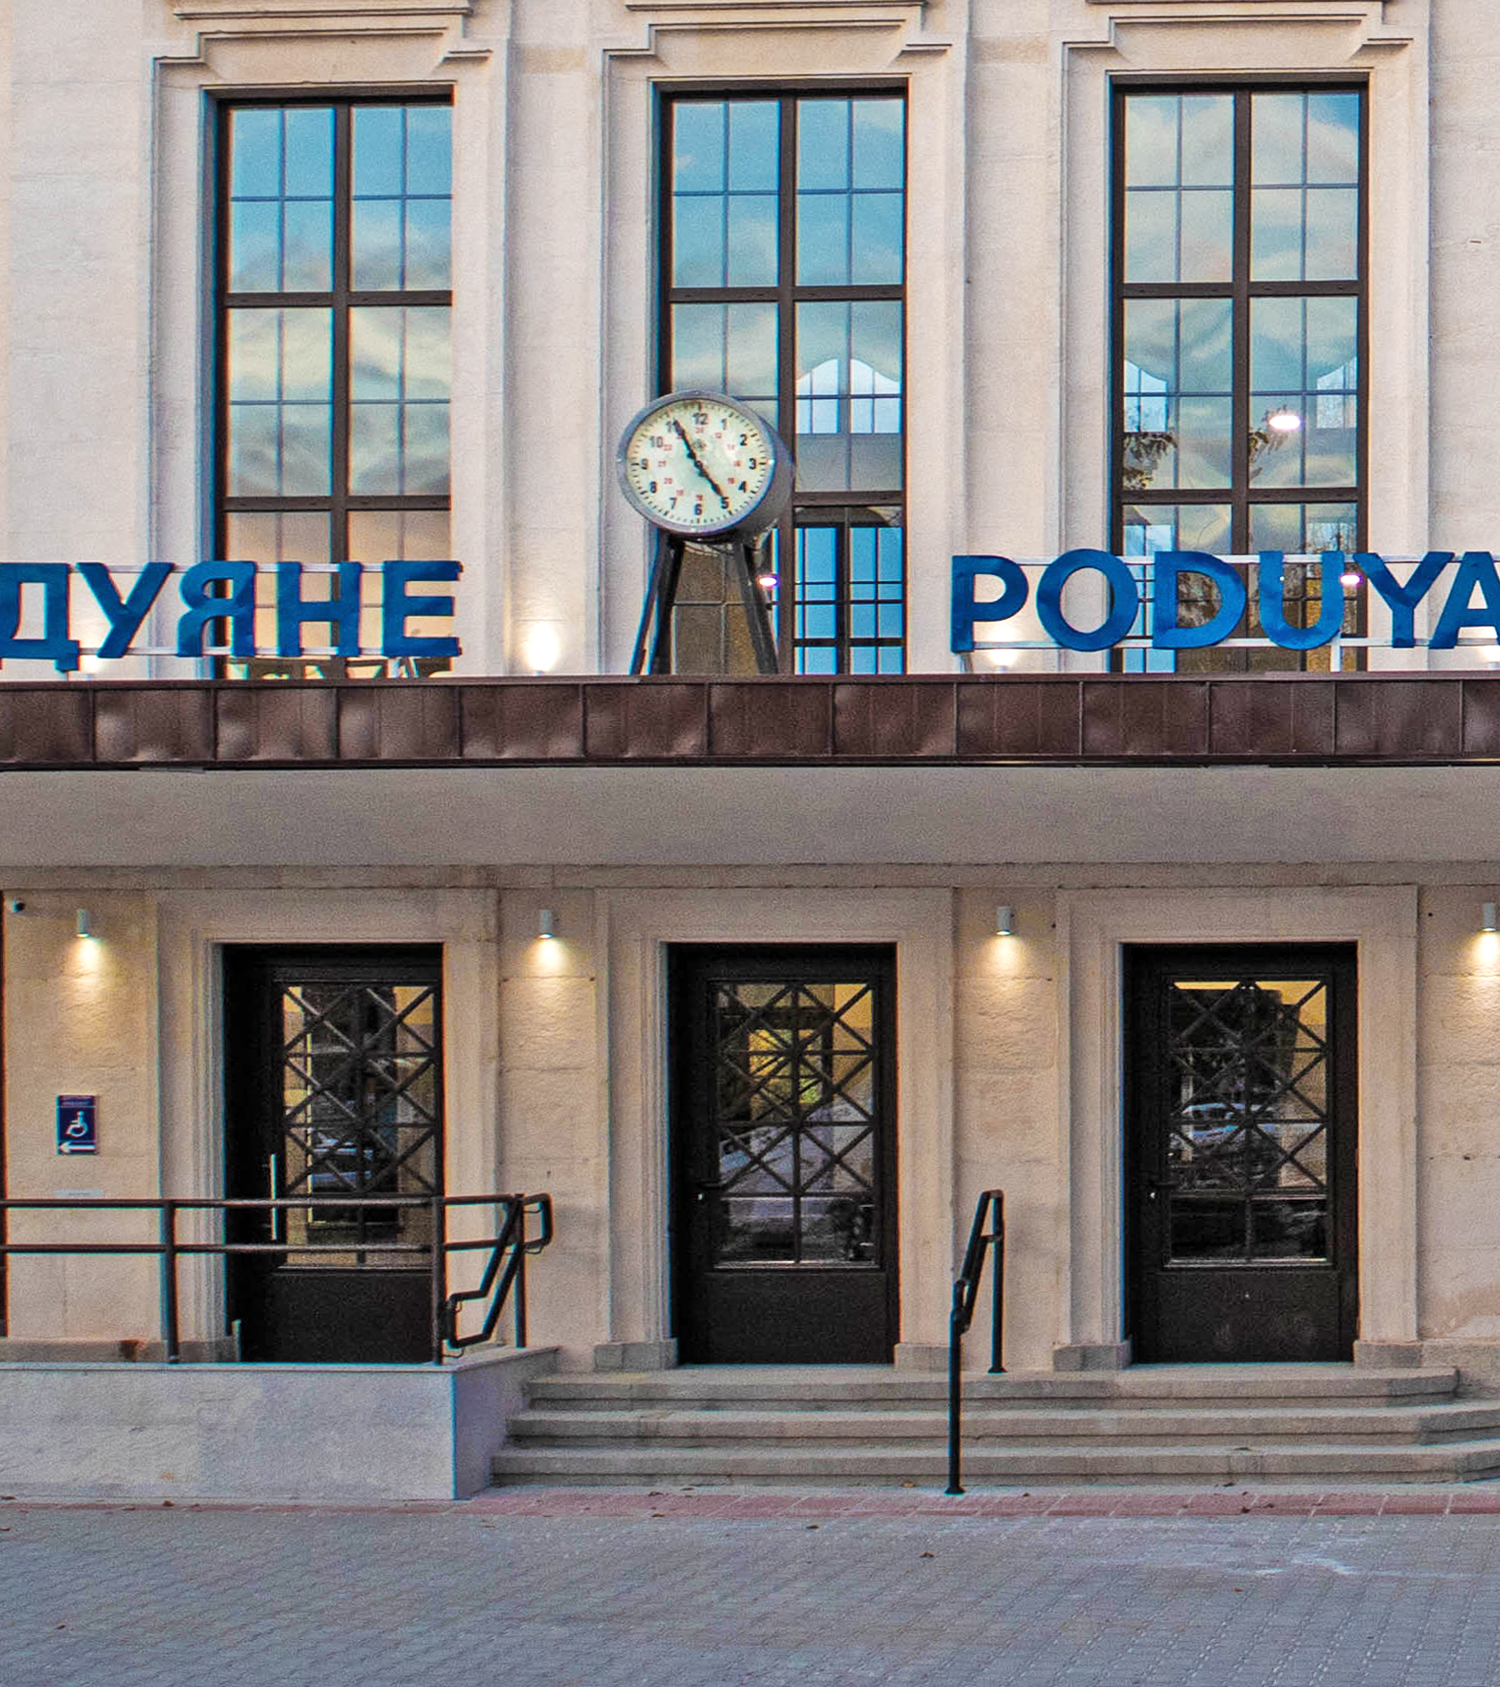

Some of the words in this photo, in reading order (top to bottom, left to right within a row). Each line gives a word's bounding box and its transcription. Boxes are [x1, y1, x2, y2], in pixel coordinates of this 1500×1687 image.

[692, 413, 708, 425] 12
[720, 418, 728, 431] 1
[649, 436, 664, 448] 10
[739, 434, 748, 446] 2
[640, 458, 649, 470] 9
[748, 457, 757, 470] 3
[649, 481, 657, 493] 8
[738, 481, 747, 493] 4
[669, 497, 677, 509] 7
[720, 496, 730, 509] 5
[694, 503, 702, 516] 6
